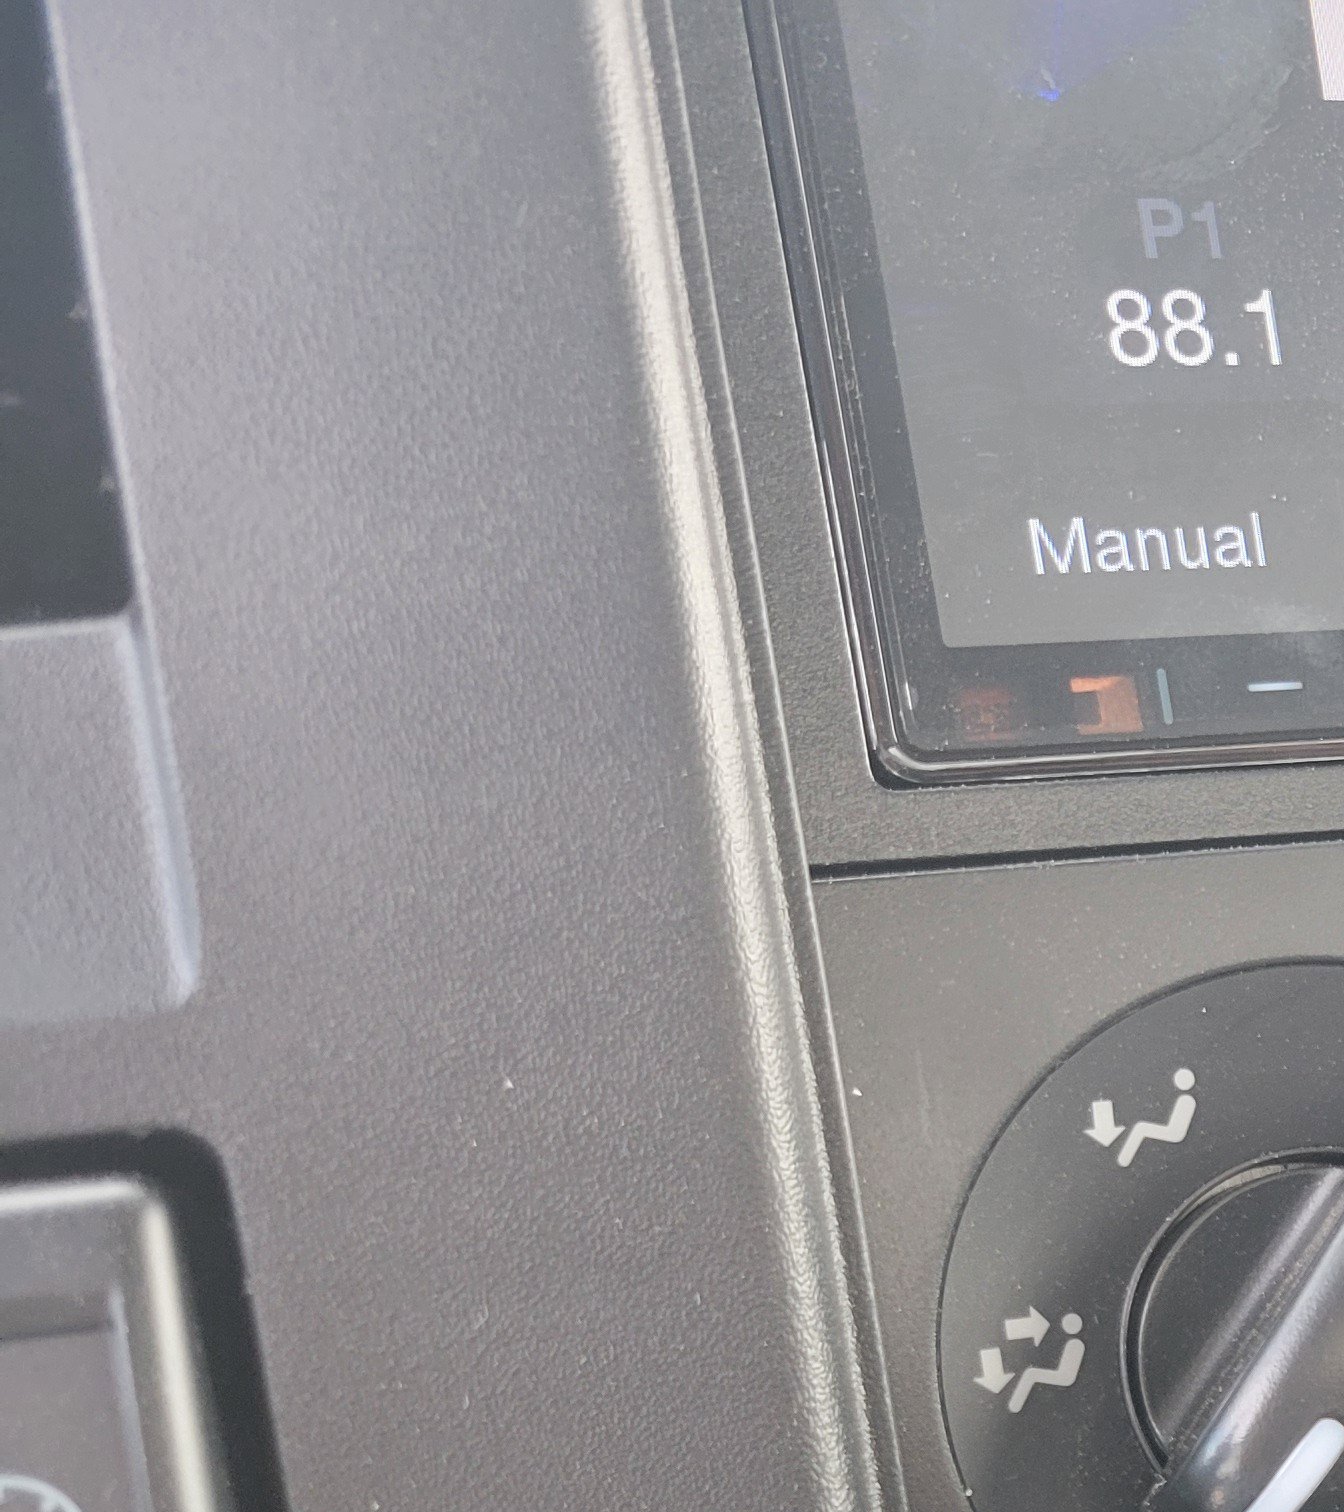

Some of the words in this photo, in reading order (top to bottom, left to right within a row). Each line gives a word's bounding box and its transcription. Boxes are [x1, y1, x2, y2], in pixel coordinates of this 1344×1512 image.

[1136, 199, 1226, 260] P1
[1105, 288, 1284, 369] 88.1
[1026, 513, 1268, 576] Manual
